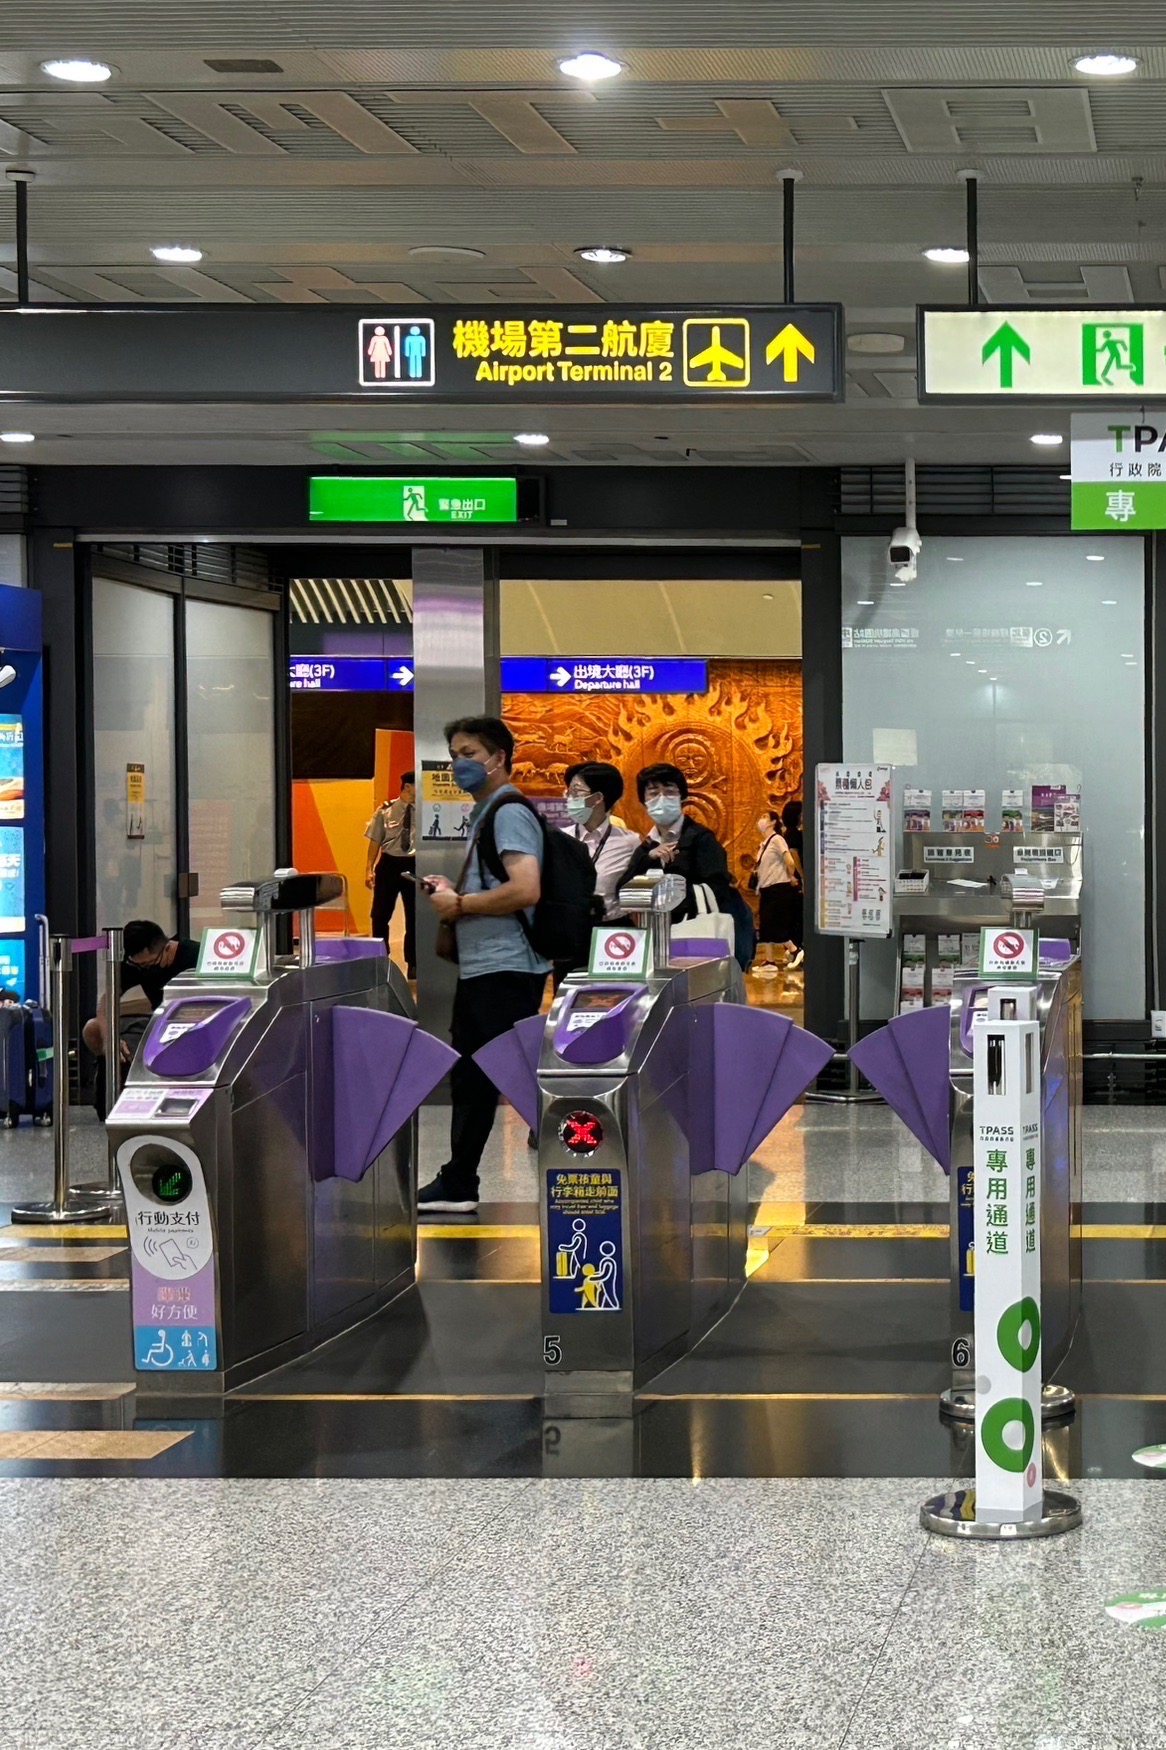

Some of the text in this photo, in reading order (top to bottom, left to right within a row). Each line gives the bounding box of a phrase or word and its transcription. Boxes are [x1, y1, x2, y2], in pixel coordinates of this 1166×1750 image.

[453, 320, 674, 358] 機場第二航廈
[475, 361, 673, 385] Airport Terminal 2
[451, 510, 473, 519] EXIT
[574, 679, 641, 691] Departure hall
[979, 1126, 1015, 1135] TPASS
[986, 1149, 1009, 1254] 專用通道
[1025, 1148, 1036, 1253] 專用通道
[138, 1211, 200, 1226] 行動支付
[151, 1304, 199, 1320] 好方便
[543, 1335, 562, 1365] 5
[951, 1337, 970, 1368] 6
